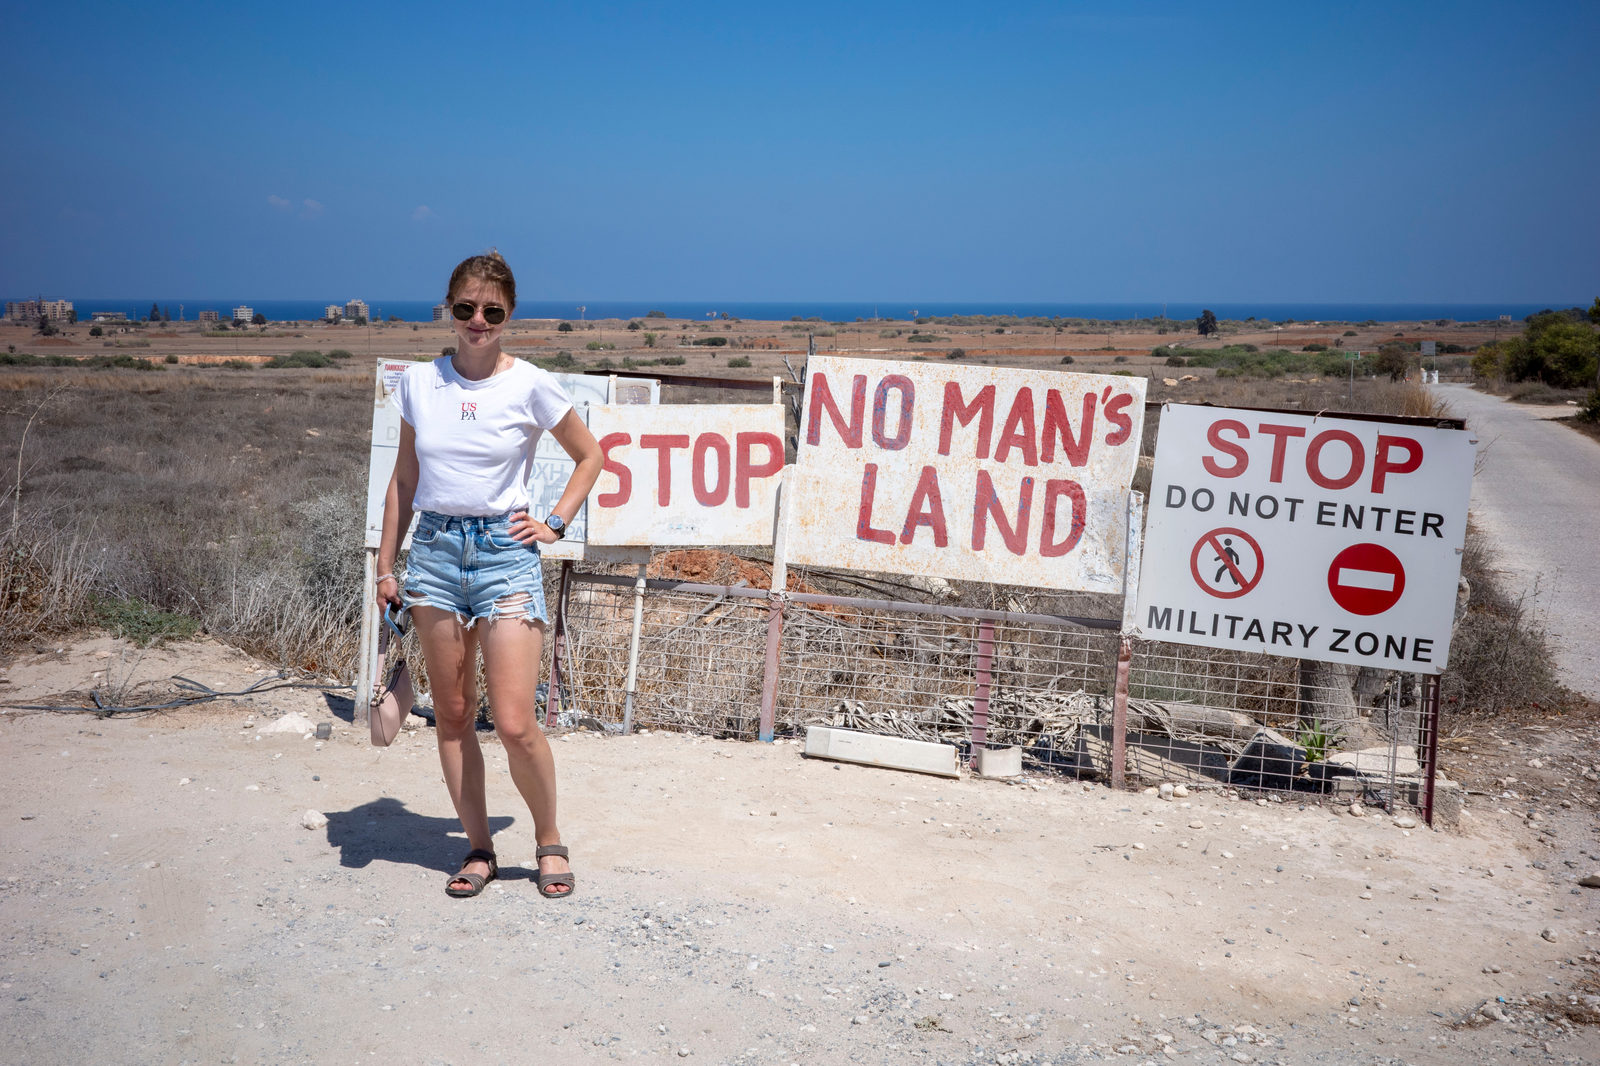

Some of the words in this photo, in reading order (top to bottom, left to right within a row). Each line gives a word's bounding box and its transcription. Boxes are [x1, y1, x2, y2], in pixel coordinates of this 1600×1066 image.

[460, 411, 477, 421] PA
[461, 402, 477, 412] US
[807, 373, 916, 451] NO
[598, 431, 785, 508] STOP
[1202, 419, 1424, 494] STOP
[856, 463, 1087, 557] LAND
[1165, 485, 1215, 512] DO
[1228, 491, 1305, 522] NOT
[1316, 501, 1445, 538] ENTER
[1147, 605, 1319, 648] MILITARY
[1328, 628, 1434, 663] ZONE
